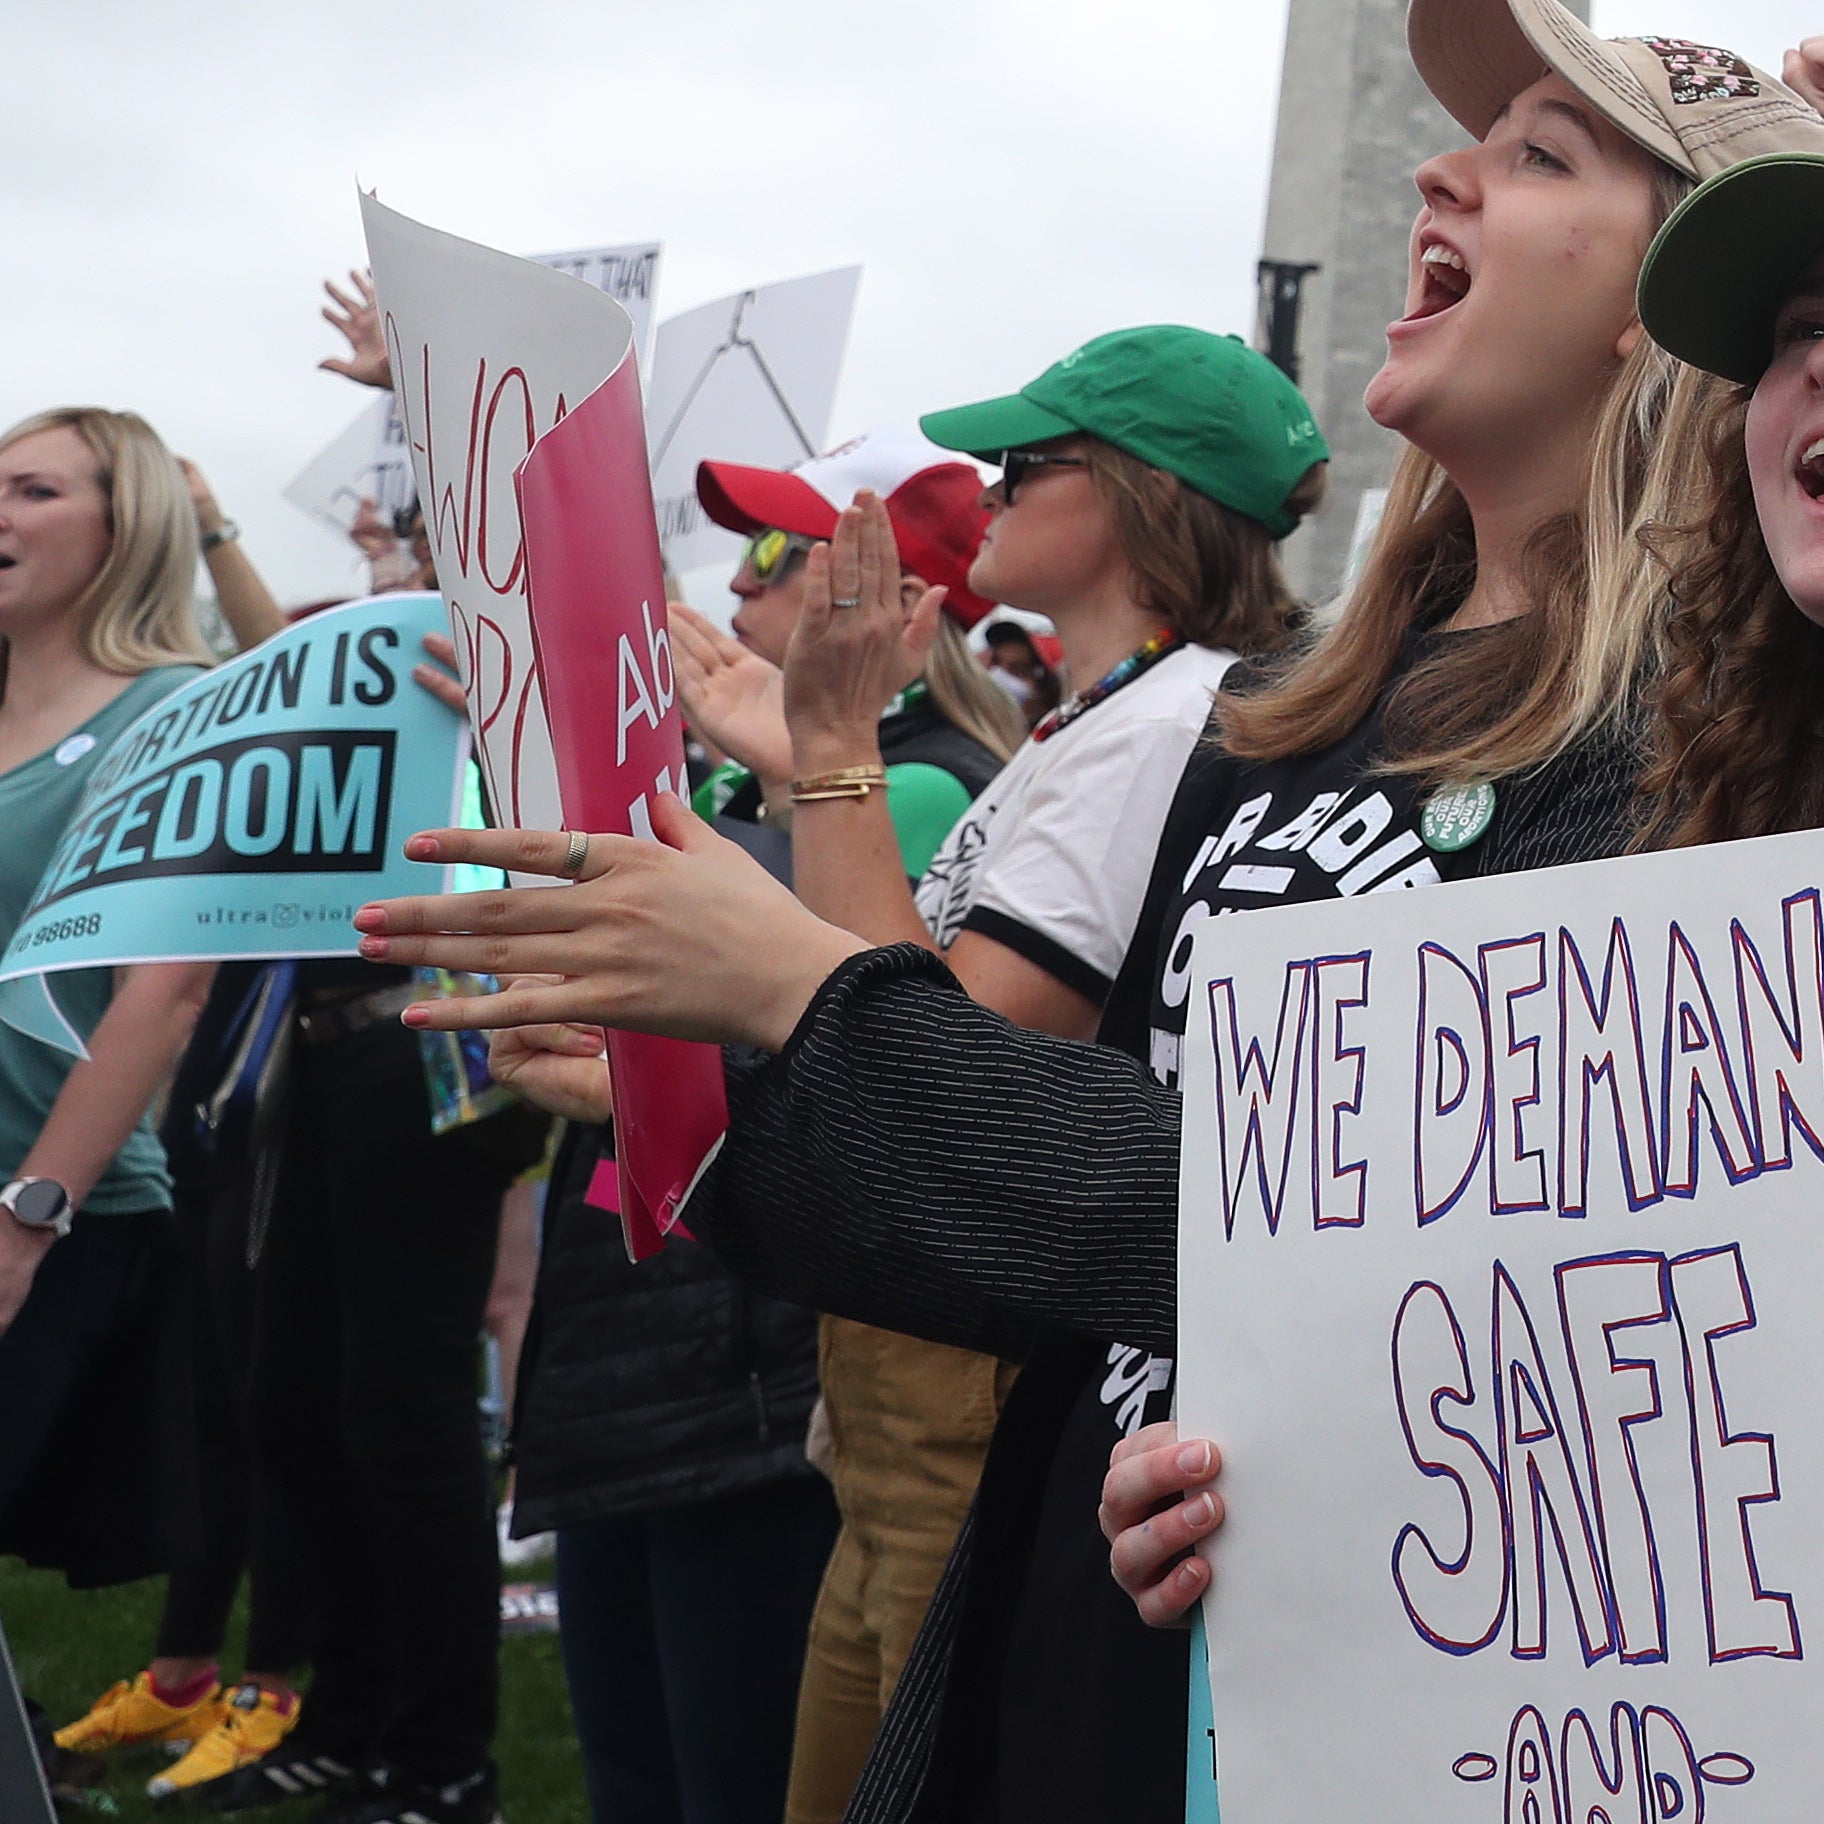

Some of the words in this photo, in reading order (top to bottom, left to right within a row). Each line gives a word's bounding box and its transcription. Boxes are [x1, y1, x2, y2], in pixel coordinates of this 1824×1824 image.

[329, 626, 399, 707] IS
[1206, 948, 1374, 1242] WE
[1390, 1240, 1805, 1670] SAFE
